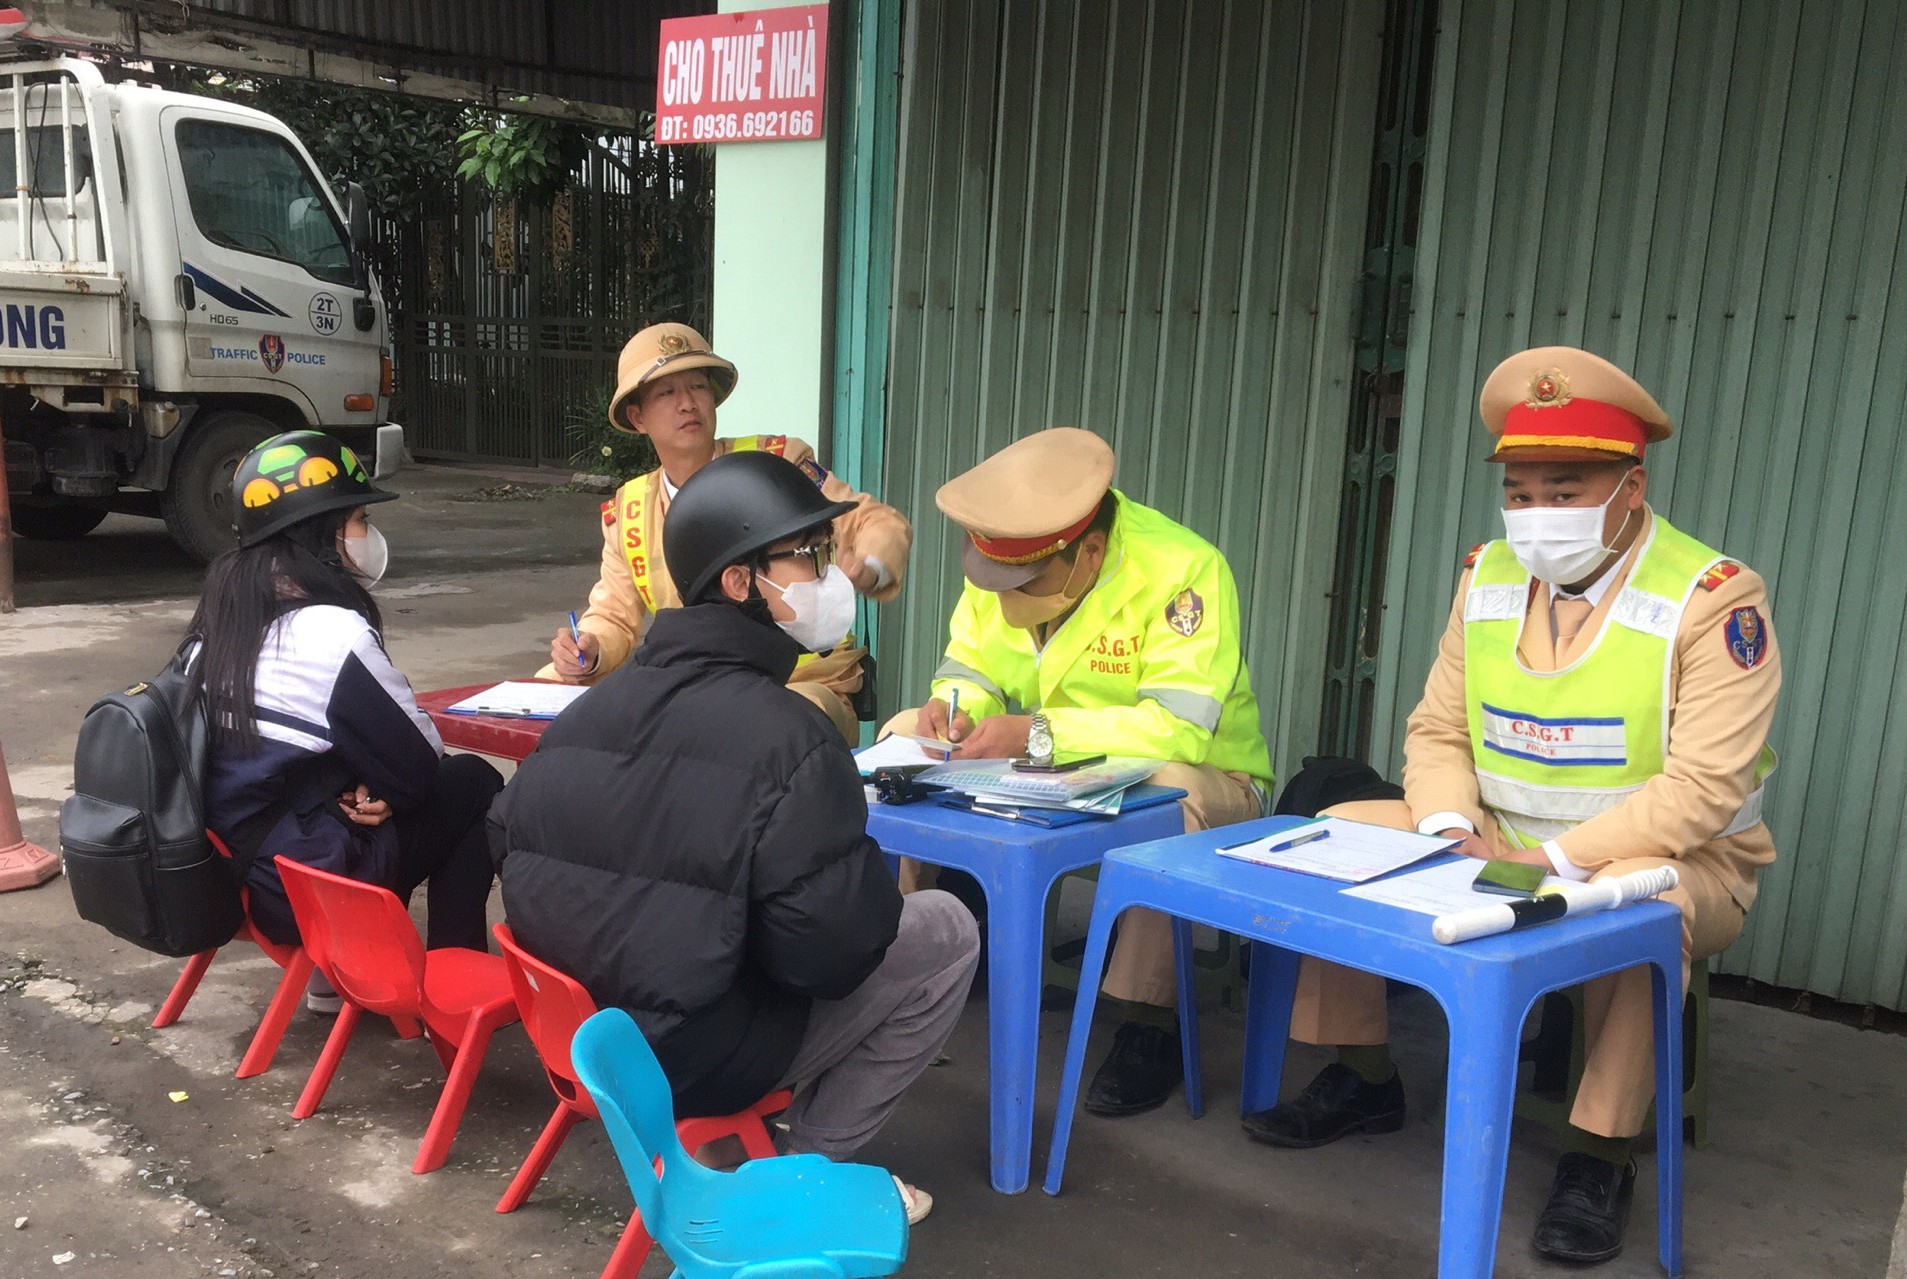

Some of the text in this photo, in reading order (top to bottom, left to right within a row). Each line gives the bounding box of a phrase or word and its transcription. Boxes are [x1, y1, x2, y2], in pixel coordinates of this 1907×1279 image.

[663, 15, 816, 106] CHO THUÊ NHÀ
[661, 110, 814, 141] ĐT: 0936.692166
[317, 298, 334, 313] 2T
[0, 304, 66, 350] NG
[209, 314, 239, 325] HD65
[316, 316, 334, 331] 3N
[209, 347, 326, 365] TRAFFIC POLICE
[1085, 635, 1139, 657] .S.G.T
[1090, 659, 1131, 674] POLICE
[1512, 720, 1574, 742] C.S.G.T
[1526, 743, 1556, 756] POLICE
